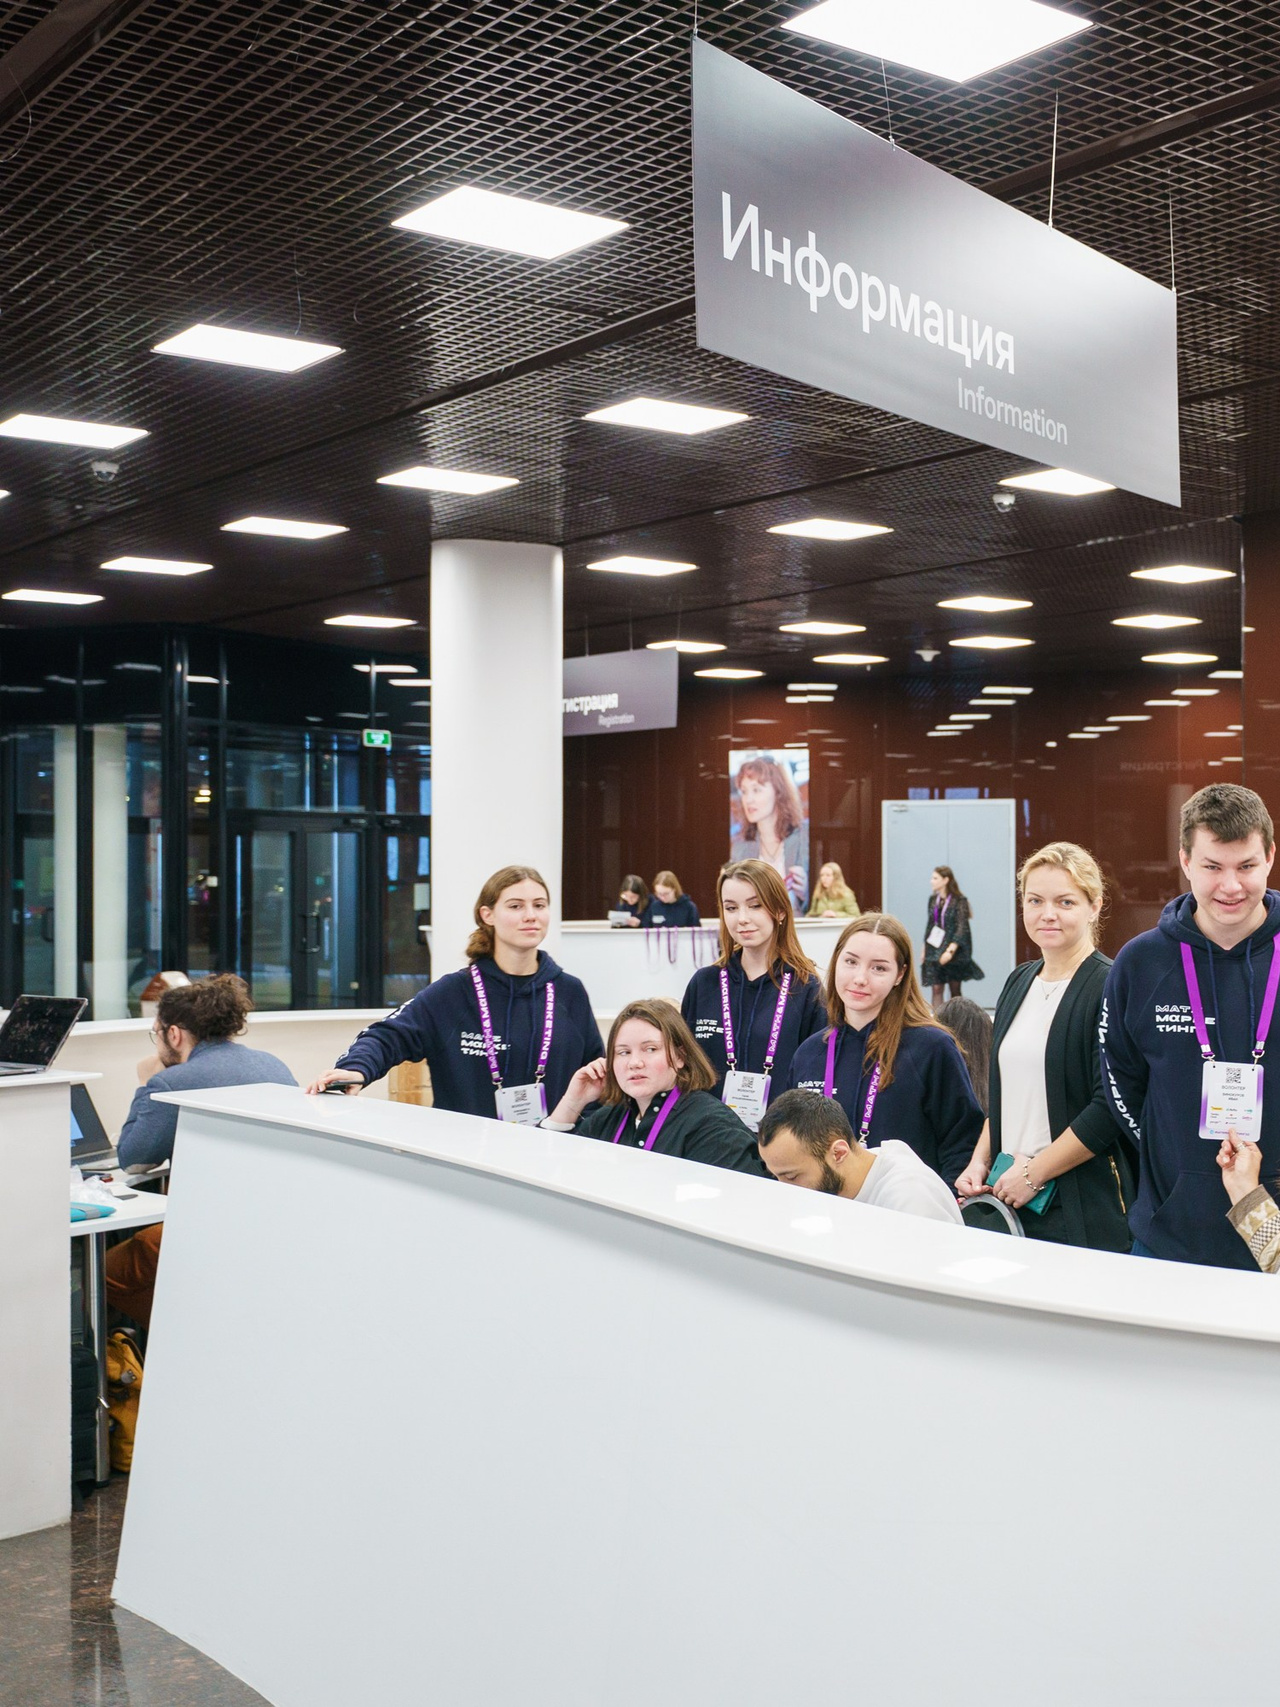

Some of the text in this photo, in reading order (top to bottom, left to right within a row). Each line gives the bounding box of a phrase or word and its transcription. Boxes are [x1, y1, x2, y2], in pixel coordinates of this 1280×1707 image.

[722, 191, 1015, 374] Информация
[957, 377, 1068, 445] Information
[1155, 1004, 1193, 1013] МАТ
